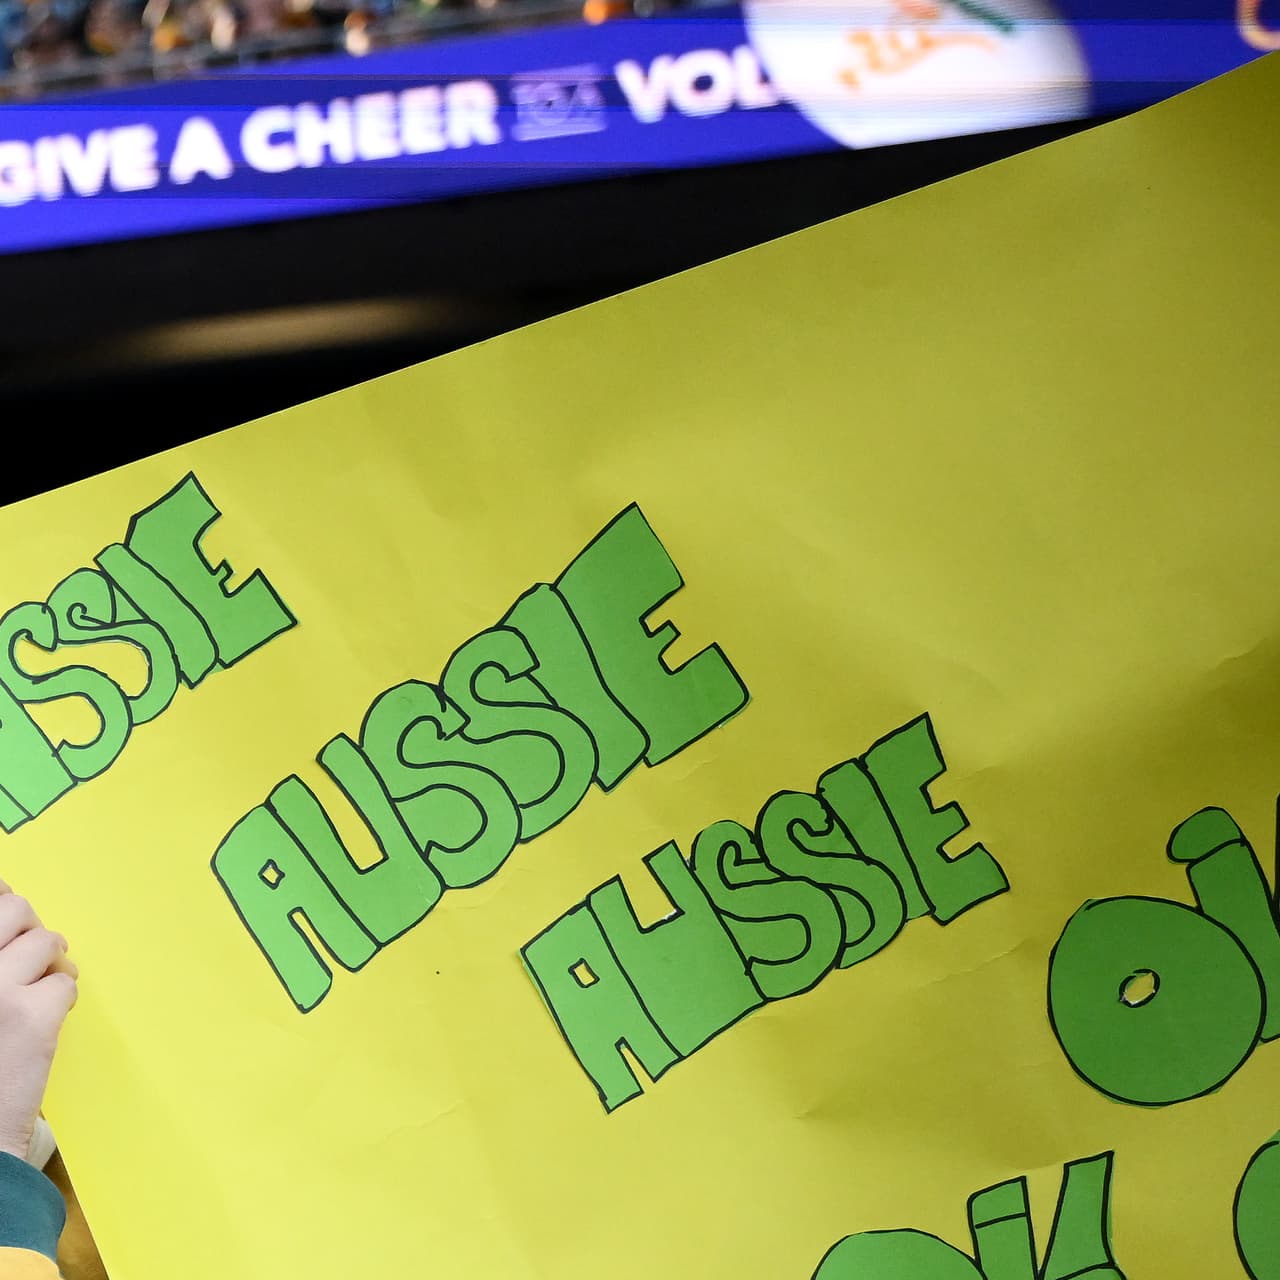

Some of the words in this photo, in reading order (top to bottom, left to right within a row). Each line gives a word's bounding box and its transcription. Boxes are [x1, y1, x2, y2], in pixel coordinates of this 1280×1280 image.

[168, 117, 233, 184] A
[240, 80, 501, 174] CHEER
[210, 501, 753, 1014] AUSSIE
[519, 712, 1011, 1114] AUSSIE
